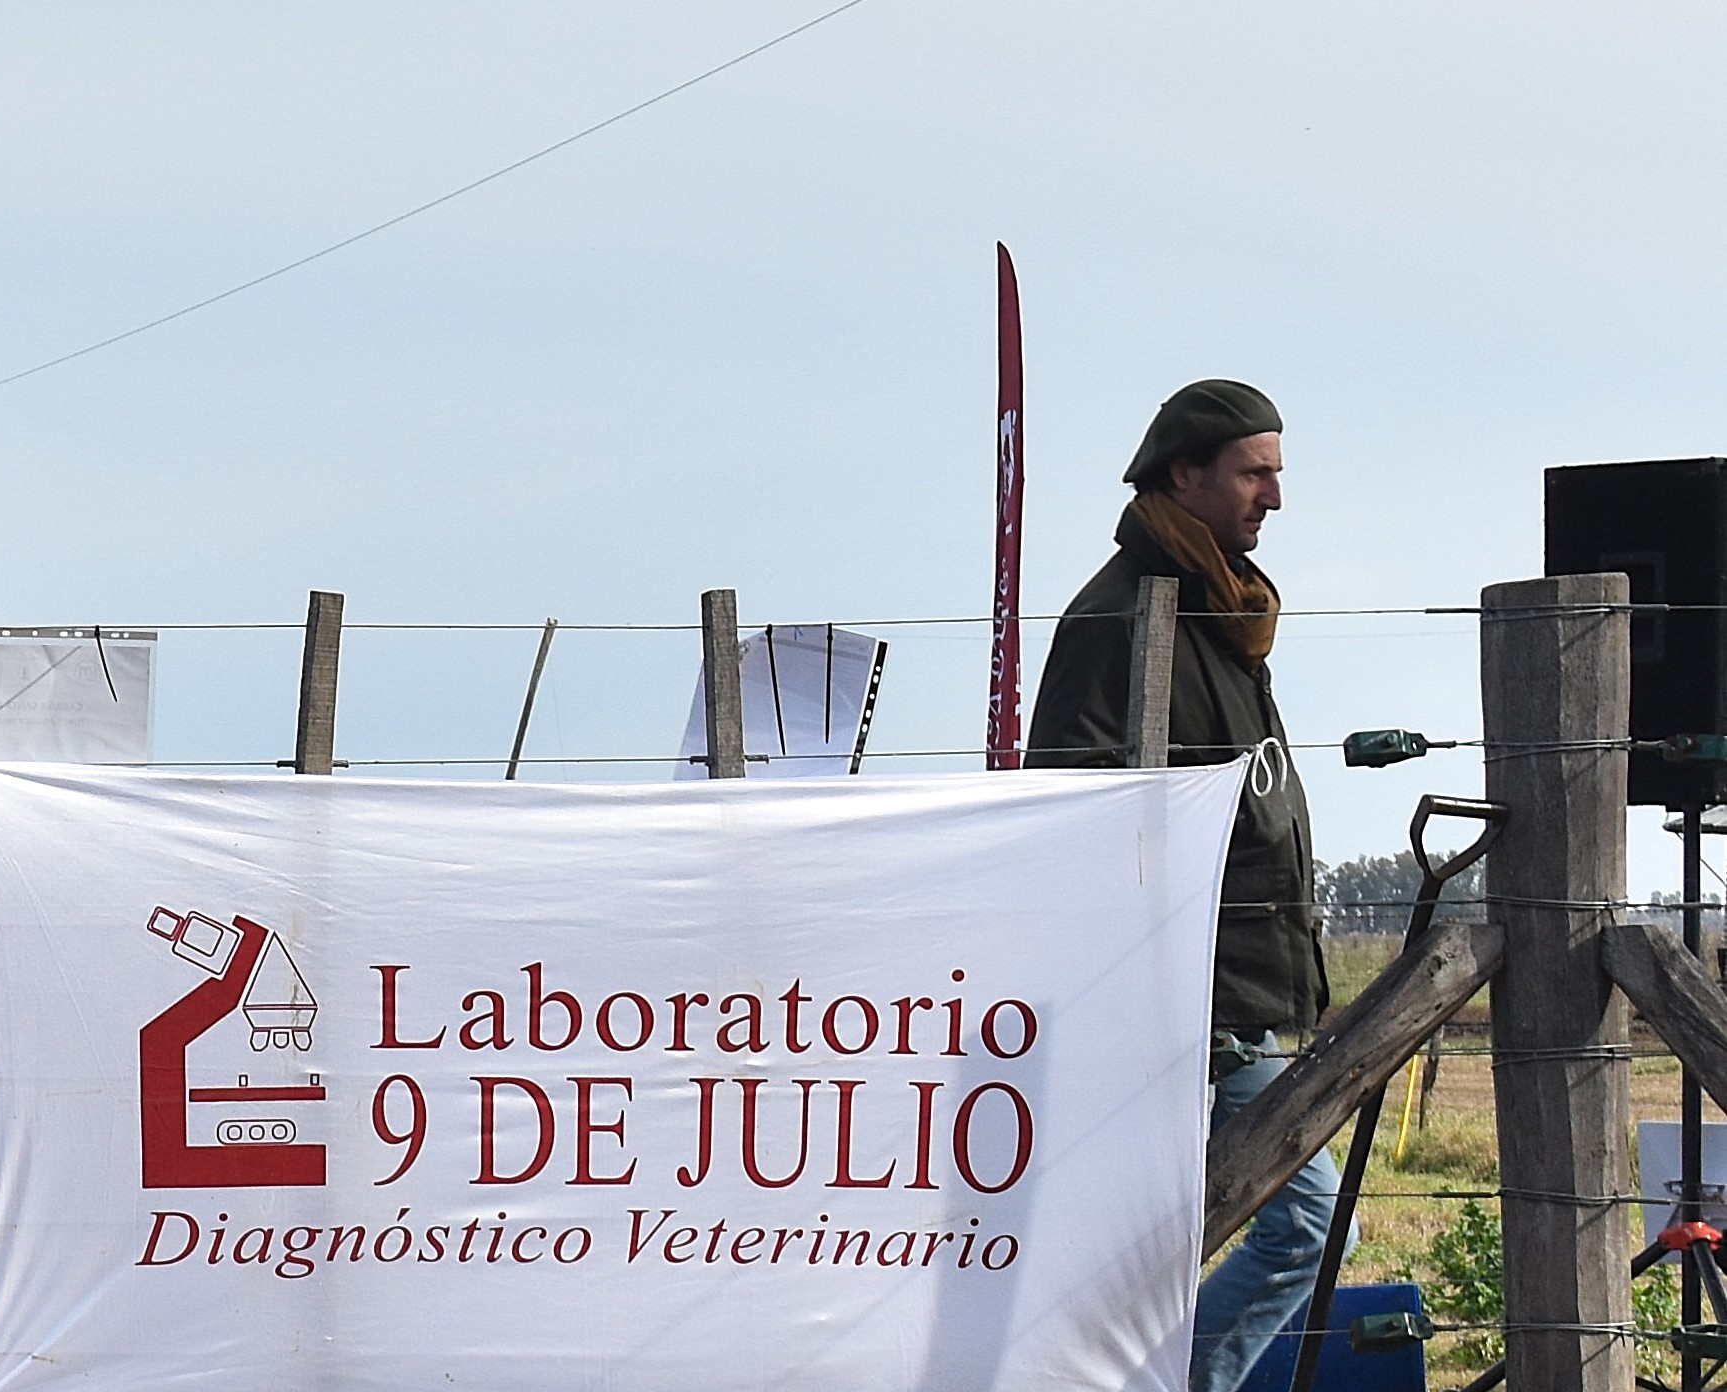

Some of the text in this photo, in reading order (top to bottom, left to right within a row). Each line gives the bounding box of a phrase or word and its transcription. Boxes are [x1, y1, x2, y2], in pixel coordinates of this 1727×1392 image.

[369, 961, 1039, 1060] Laboratorio
[372, 1074, 1036, 1195] 9 DE JULIO
[135, 1207, 1021, 1280] Diagnóstico Veterinario
